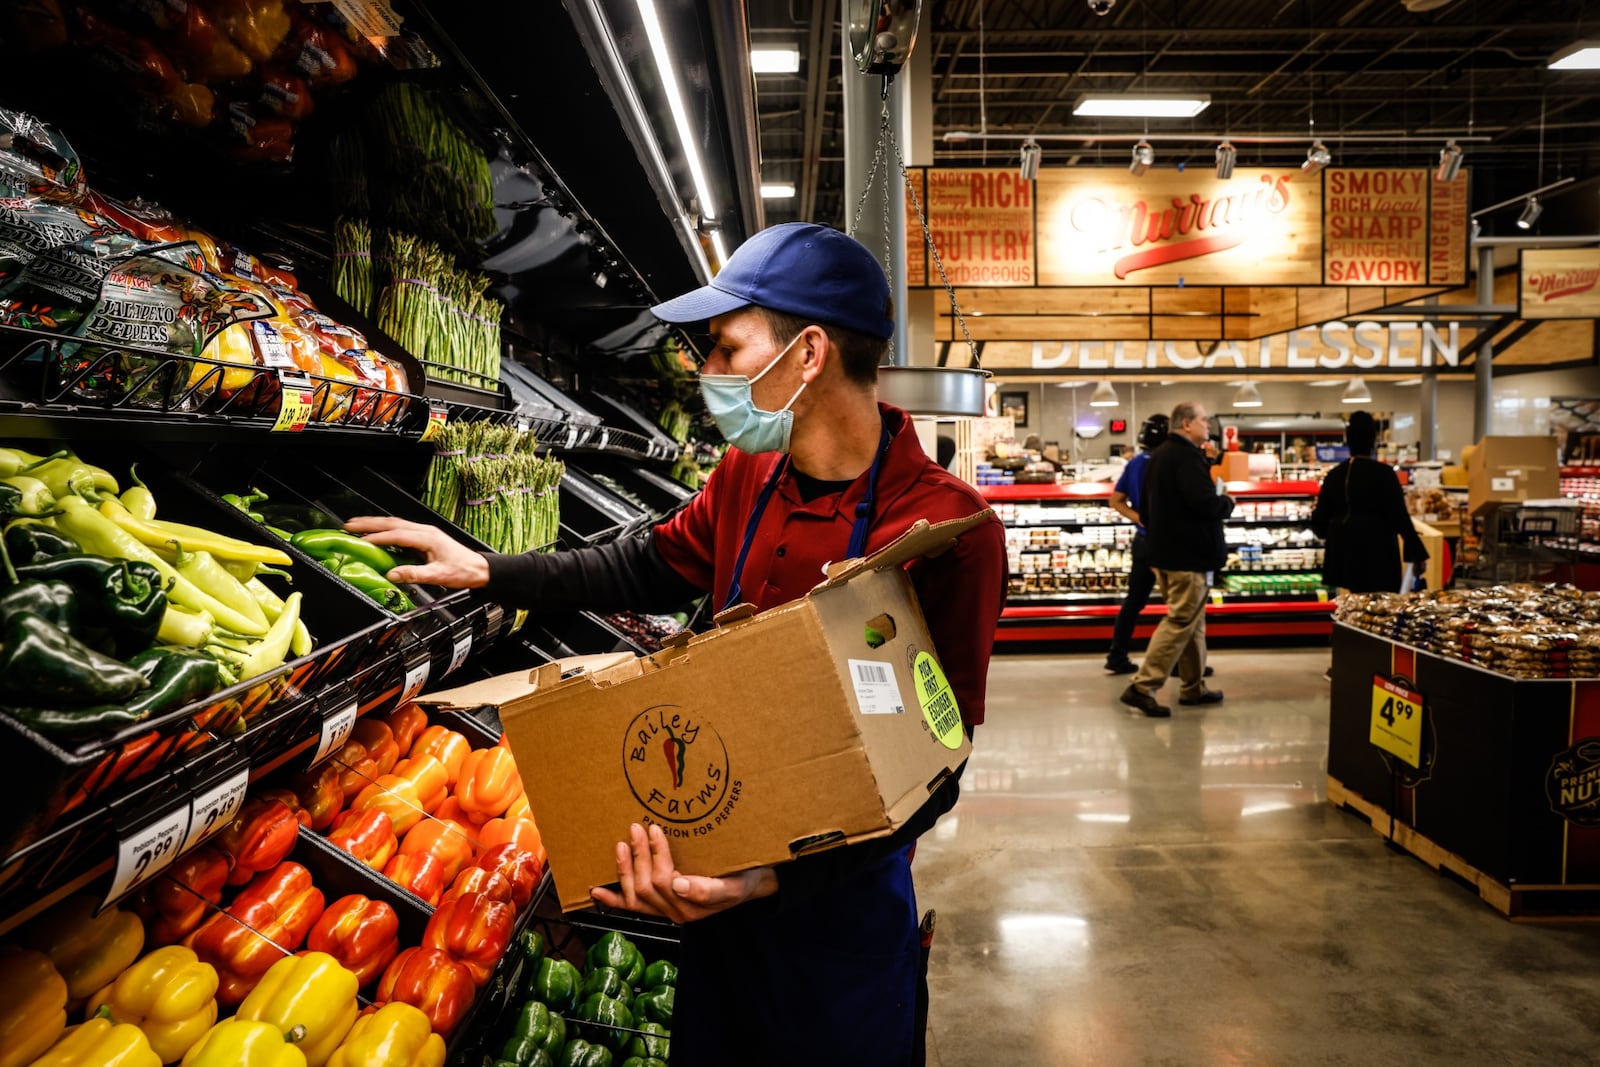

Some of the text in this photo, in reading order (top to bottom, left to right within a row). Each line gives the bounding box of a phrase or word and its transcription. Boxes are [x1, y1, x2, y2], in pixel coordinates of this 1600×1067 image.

[971, 172, 1029, 208] RICH
[1331, 171, 1423, 194] SMOKY
[1331, 197, 1421, 212] RICH local
[1331, 215, 1423, 239] SHARP
[931, 230, 1029, 262] BUTTERY
[1329, 260, 1421, 281] SAVORY
[87, 315, 170, 344] PEPPERS
[1032, 321, 1460, 369] DELICATESSEN
[923, 675, 940, 699] FIRST
[630, 711, 700, 763] Bailey
[647, 763, 722, 815] Farms
[642, 780, 743, 838] PASION FOR PEPPERS
